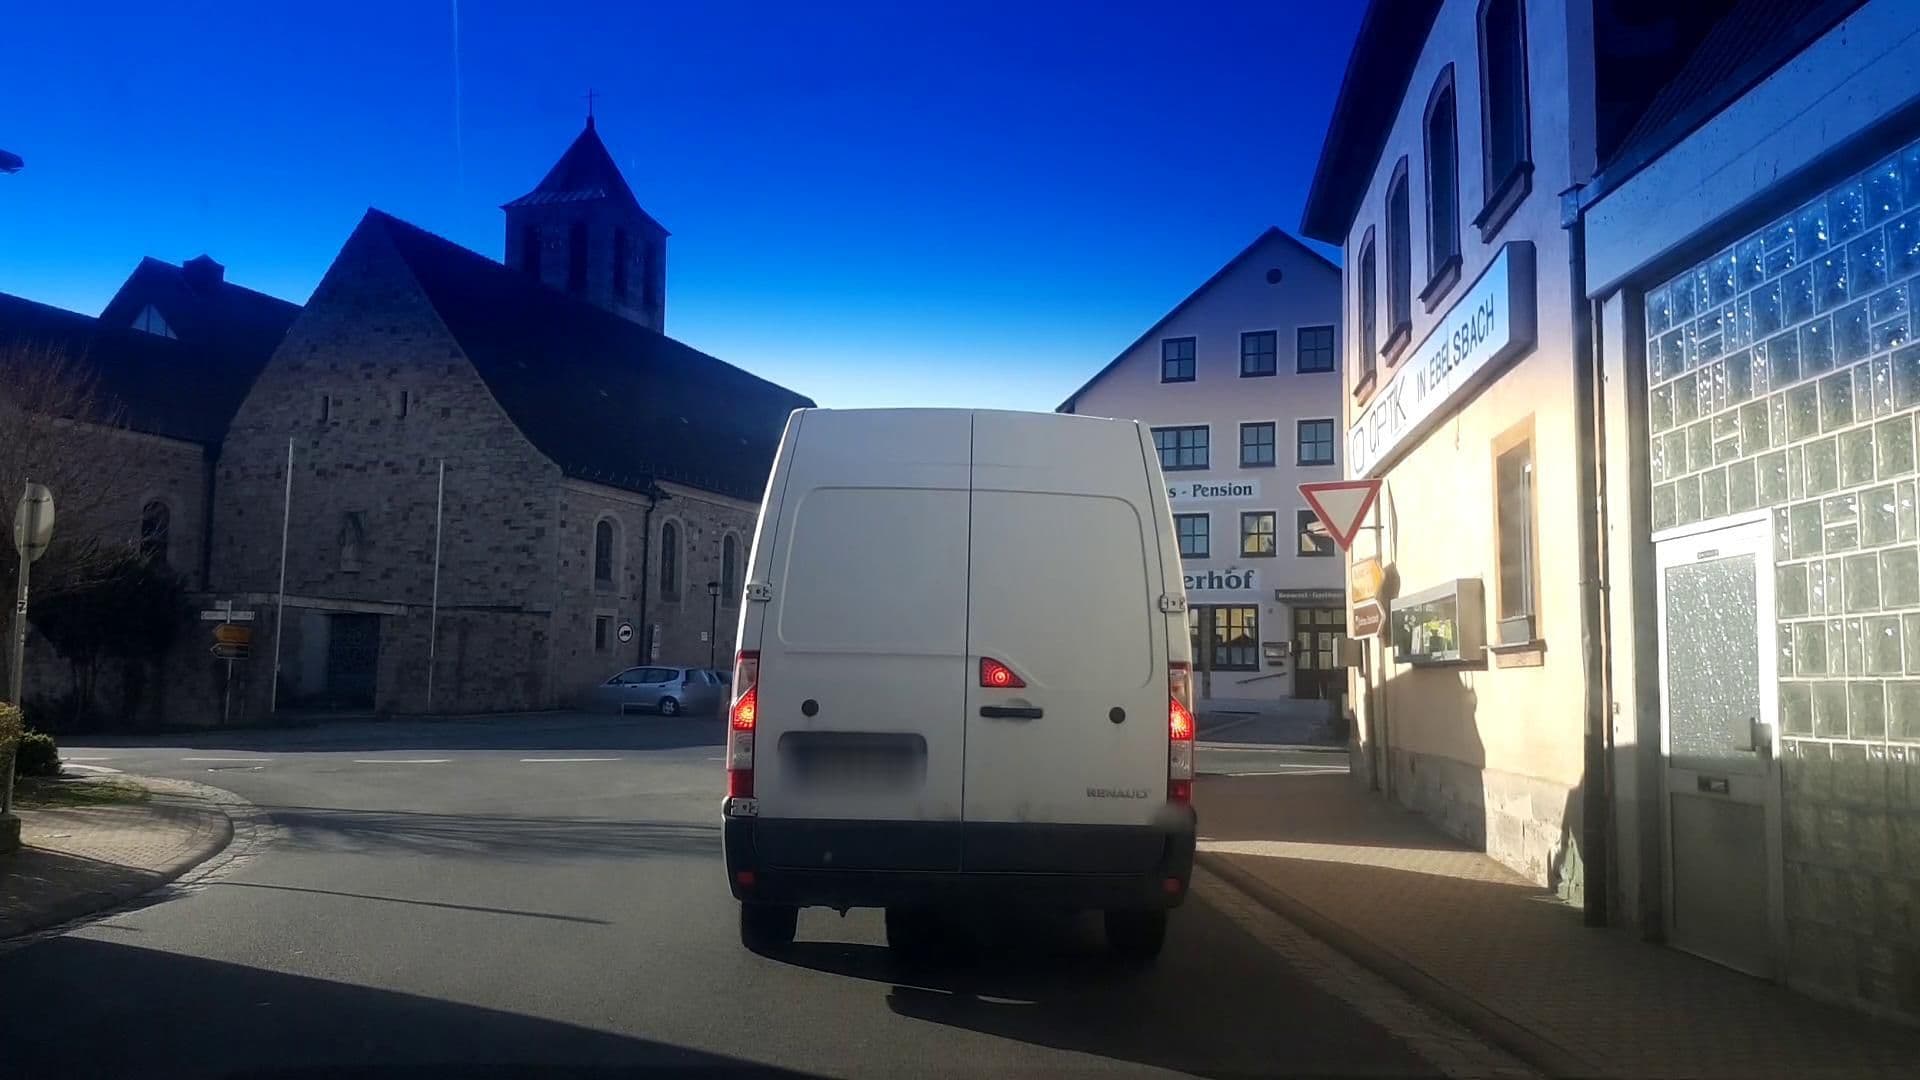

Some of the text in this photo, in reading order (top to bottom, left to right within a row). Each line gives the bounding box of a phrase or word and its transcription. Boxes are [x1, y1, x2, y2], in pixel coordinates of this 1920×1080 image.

[1416, 366, 1427, 403] IN
[1429, 292, 1495, 391] EBELSBACH
[1192, 482, 1253, 498] Pension
[1184, 570, 1255, 590] erhof
